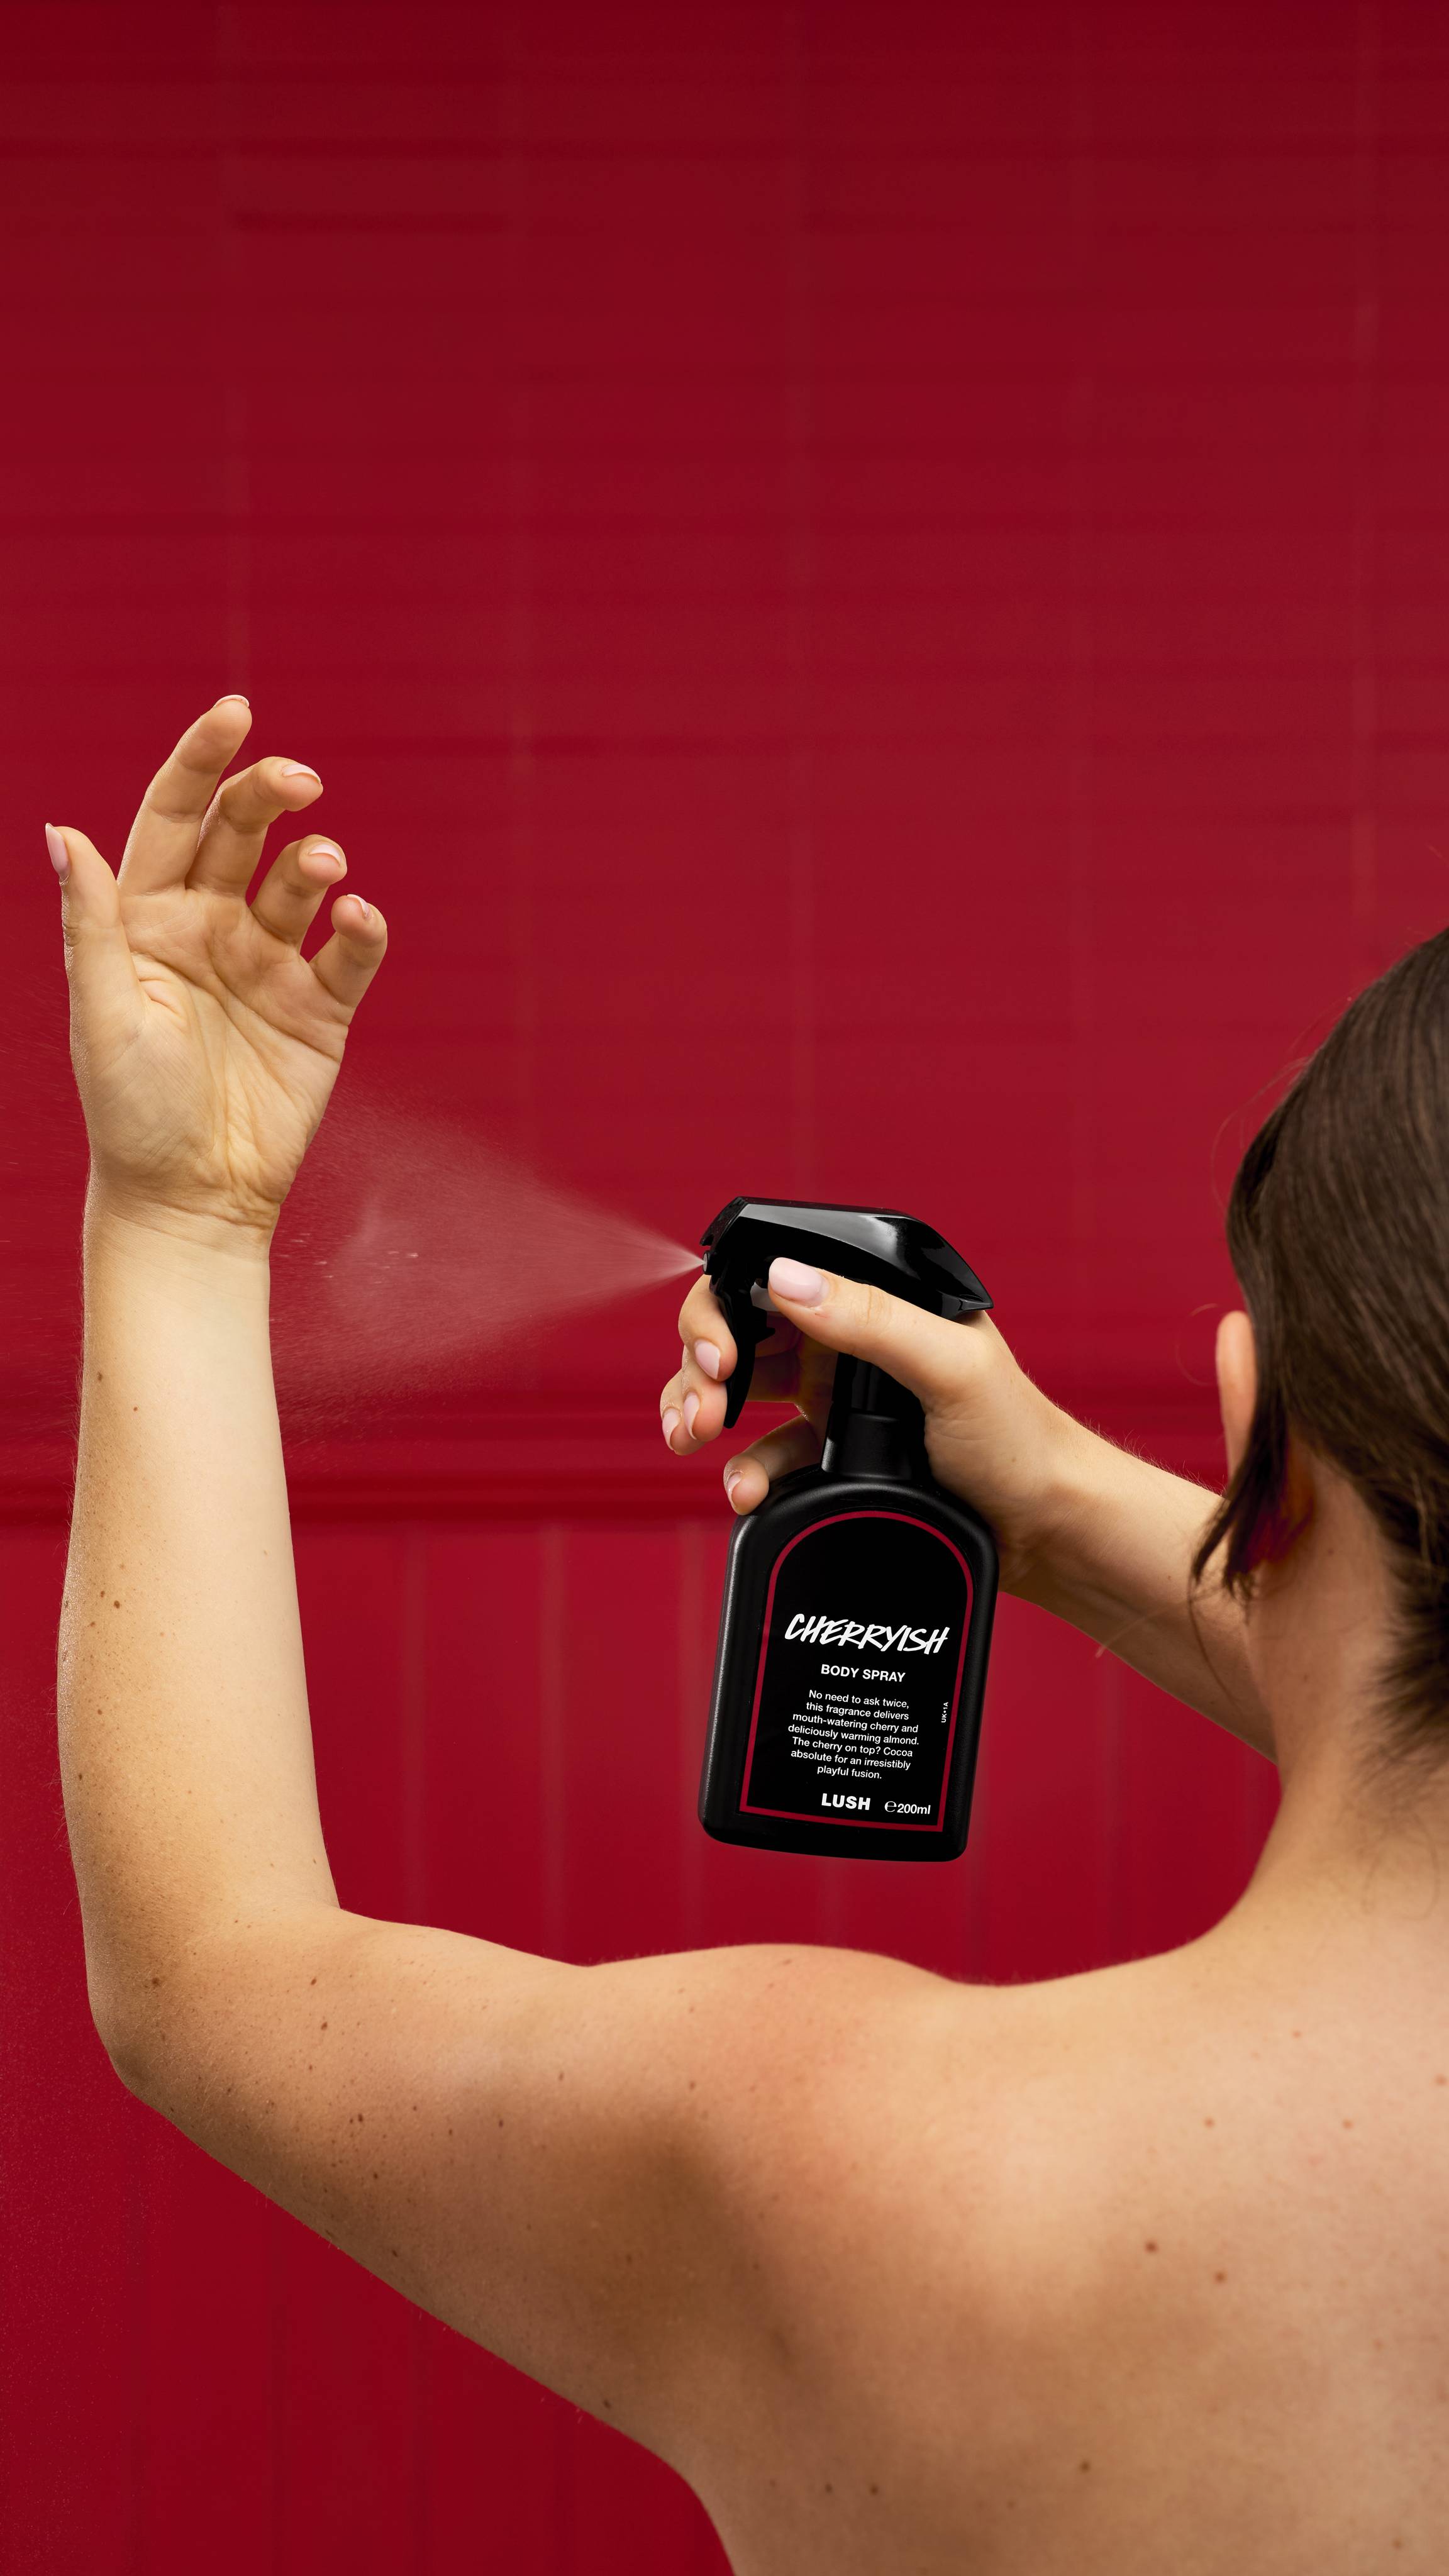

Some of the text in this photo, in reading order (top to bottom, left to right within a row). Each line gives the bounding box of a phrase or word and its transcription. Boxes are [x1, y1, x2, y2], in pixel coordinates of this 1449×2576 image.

[785, 1614, 950, 1655] CHERRYISH
[821, 1663, 906, 1682] BODY SPRAY
[809, 1689, 909, 1709] No need to ask twice,
[806, 1702, 909, 1720] this fragrance delivers
[792, 1714, 919, 1734] mouth-watering cherry and
[787, 1724, 919, 1745] deliciously warming almond.
[792, 1736, 810, 1747] The
[812, 1740, 843, 1753] cherry
[859, 1745, 881, 1756] top?
[883, 1746, 913, 1757] Cocoa
[791, 1749, 832, 1762] absolute
[834, 1754, 848, 1763] for
[864, 1757, 911, 1771] irresistibly
[817, 1765, 882, 1779] playful fusion.
[821, 1792, 871, 1811] LUSH
